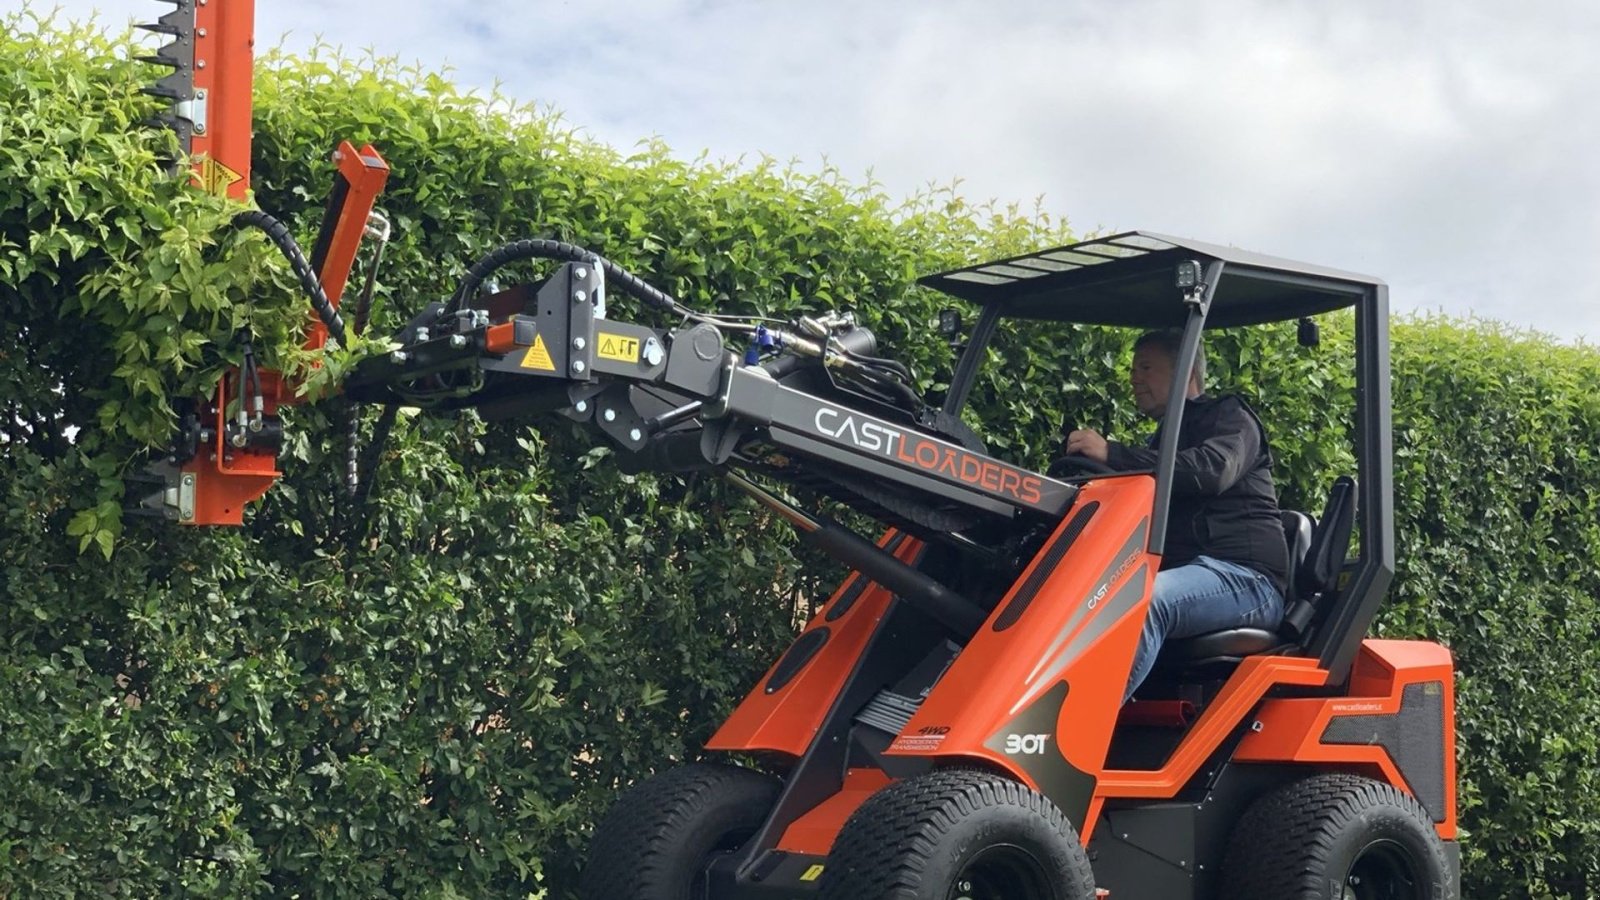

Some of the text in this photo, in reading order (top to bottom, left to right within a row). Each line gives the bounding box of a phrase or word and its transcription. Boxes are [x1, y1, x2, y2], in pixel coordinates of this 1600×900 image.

[814, 407, 1042, 505] CASTLOADERS
[918, 726, 951, 735] 4WD
[1004, 733, 1051, 755] 30T
